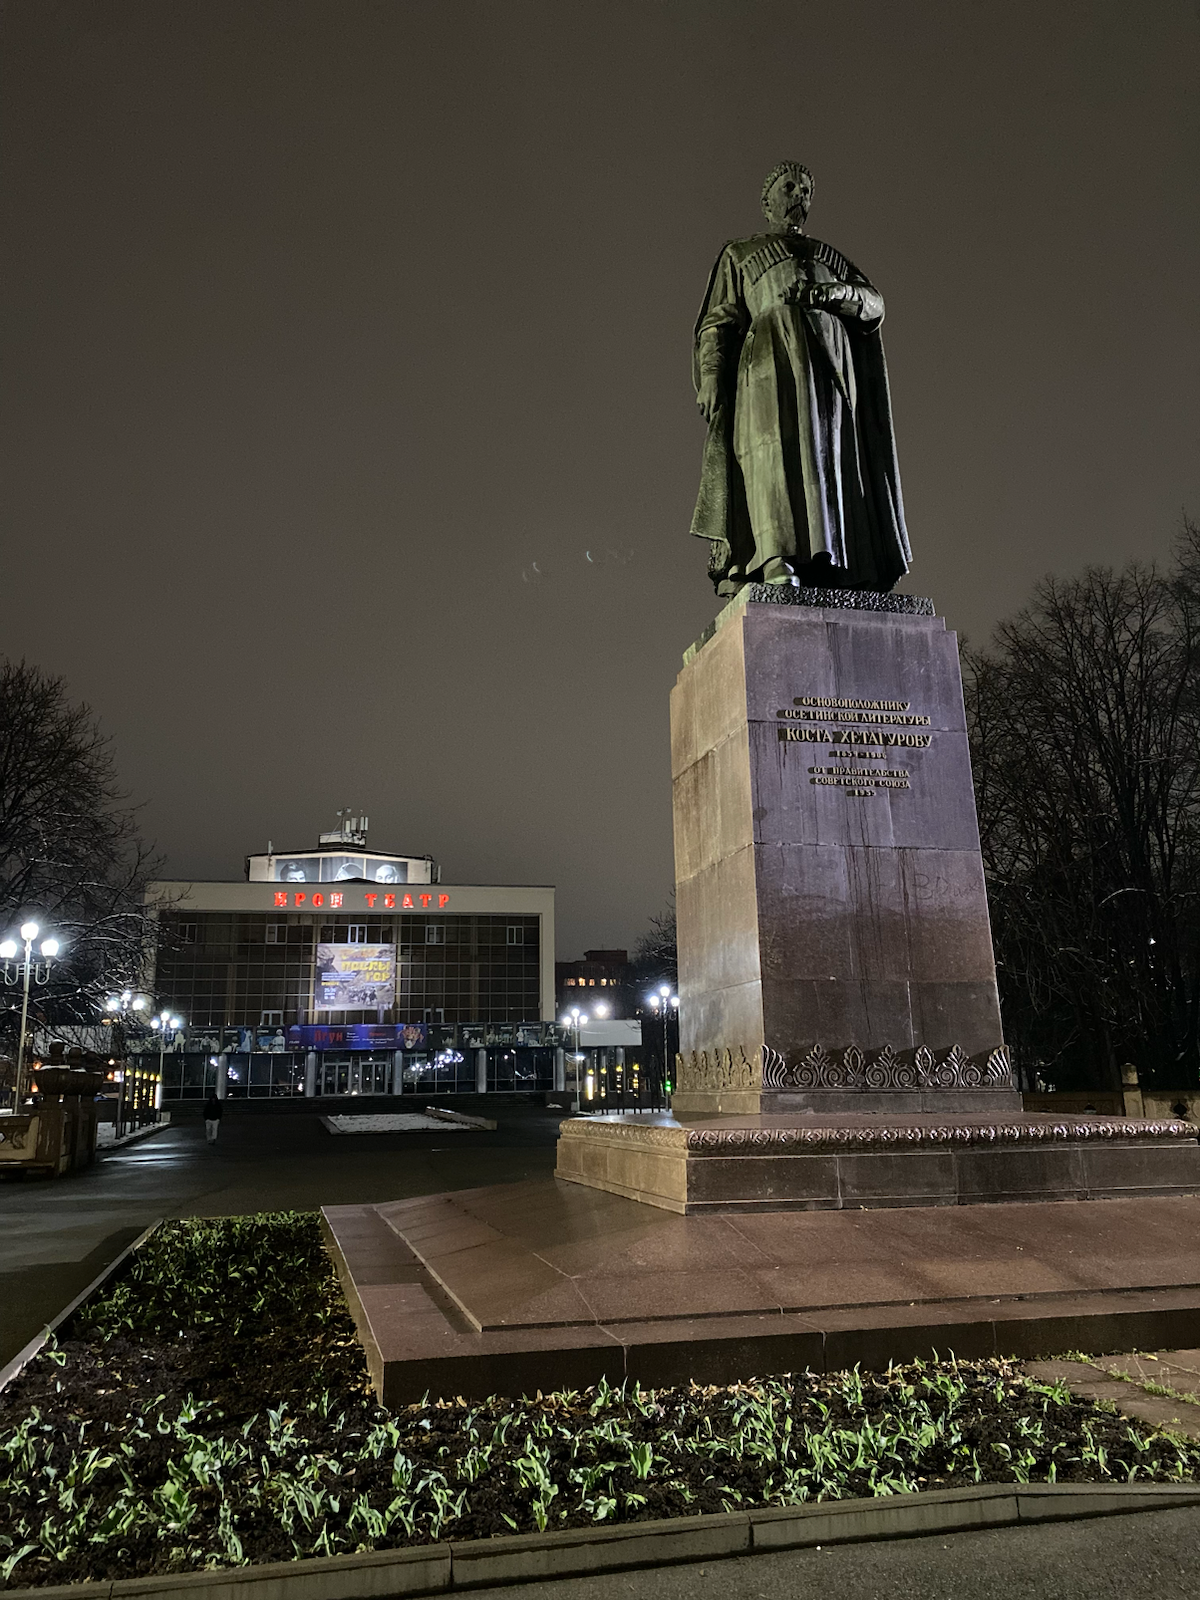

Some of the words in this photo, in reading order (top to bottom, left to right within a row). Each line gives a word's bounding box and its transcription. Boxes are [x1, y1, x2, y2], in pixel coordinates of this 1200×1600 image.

[802, 697, 911, 711] ОСНОВОПОЛОЖНИКУ
[861, 714, 931, 726] ЛИТЕРАТУРЫ
[787, 727, 833, 742] КОСТА
[840, 730, 933, 748] ХЕТАГУРОВУ
[814, 766, 826, 775] ОТ
[832, 767, 911, 778] ПРАВИТЕЛЬСТВА
[815, 777, 876, 787] СОВЕТСКОГО
[879, 779, 911, 789] СОЮЗА
[365, 893, 450, 908] ТЕАТР
[366, 971, 391, 982] ГОР
